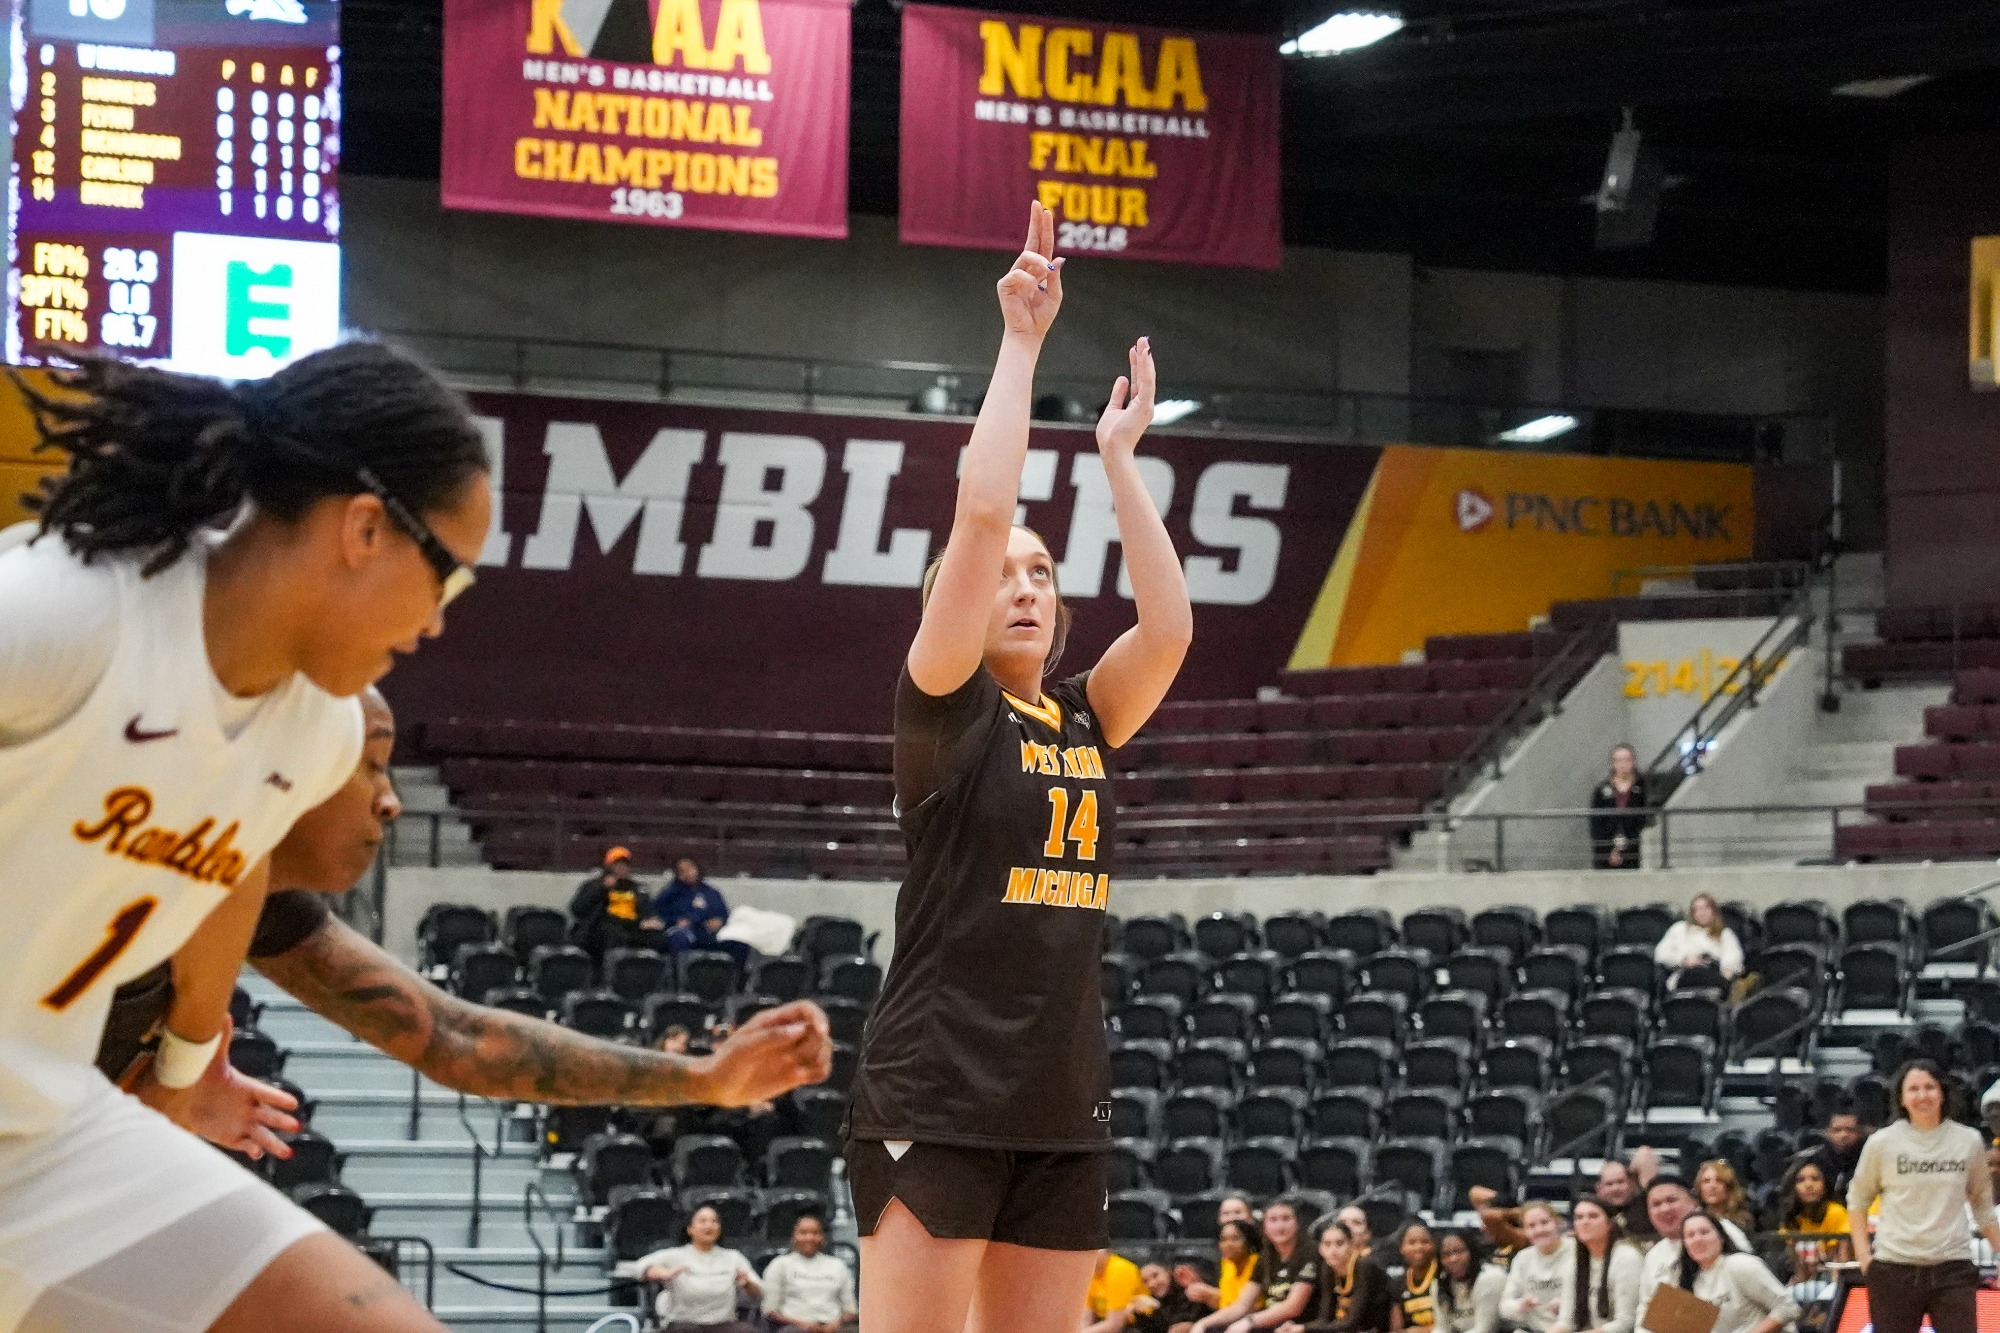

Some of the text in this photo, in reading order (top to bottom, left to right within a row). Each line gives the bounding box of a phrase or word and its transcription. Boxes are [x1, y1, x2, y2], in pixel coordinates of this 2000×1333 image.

[525, 0, 772, 75] NAA
[523, 59, 774, 101] MEN'S BASKETBALL
[979, 20, 1209, 113] NCAA
[533, 87, 762, 147] NATIONAL
[974, 99, 1210, 139] MEN'S BASKETBALL
[514, 137, 778, 198] CHAMPIONS
[1029, 130, 1157, 179] FINAL
[610, 187, 684, 219] 1963
[1037, 180, 1149, 227] FOUR
[1058, 221, 1128, 252] 2018
[34, 307, 88, 343] FT%
[1506, 491, 1733, 544] PNC BANK
[1044, 787, 1099, 860] 14
[37, 894, 160, 1012] 1
[1897, 1153, 1967, 1175] Broncos
